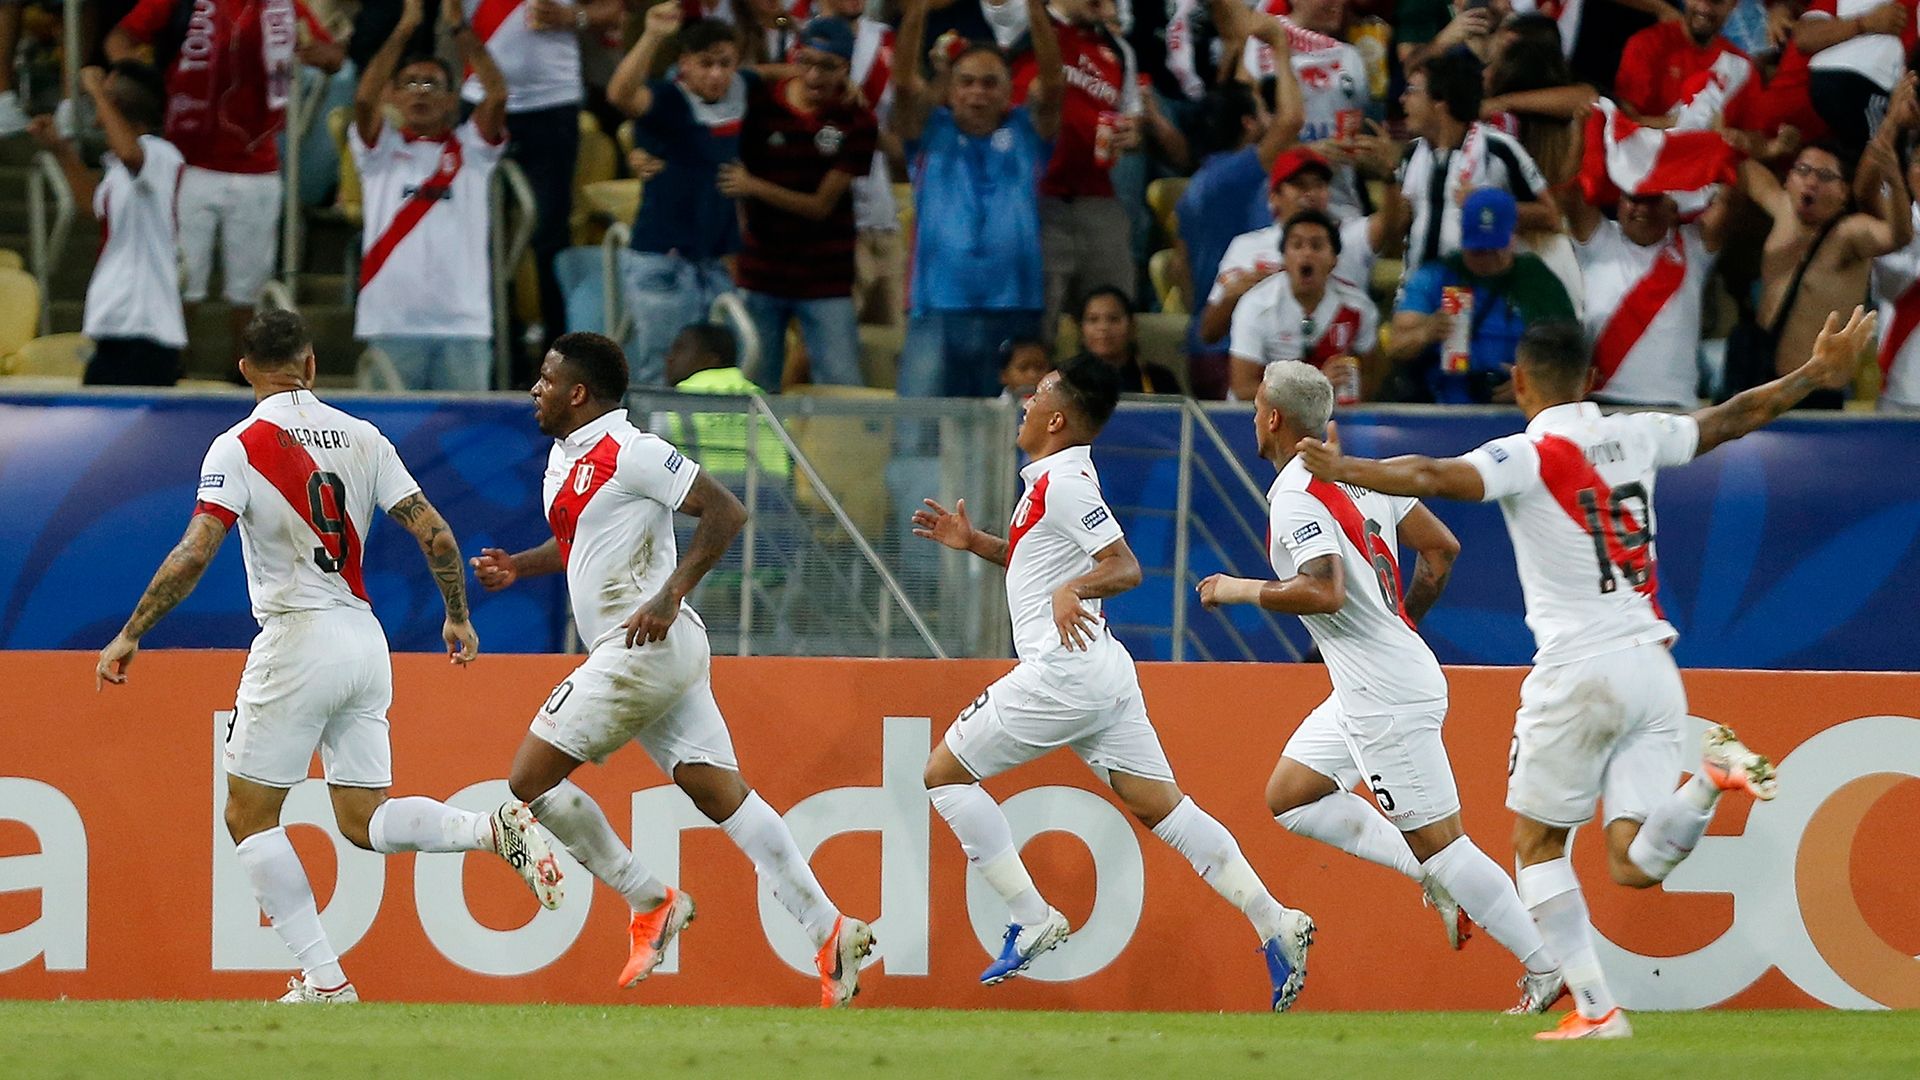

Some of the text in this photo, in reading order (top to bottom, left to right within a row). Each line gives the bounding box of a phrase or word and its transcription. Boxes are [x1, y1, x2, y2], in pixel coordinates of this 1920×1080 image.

[277, 428, 350, 449] GUERRERO
[307, 470, 348, 573] 9
[1363, 518, 1399, 617] 6
[1578, 480, 1653, 594] 19
[1370, 774, 1395, 812] 6
[0, 711, 1145, 982] a bordo
